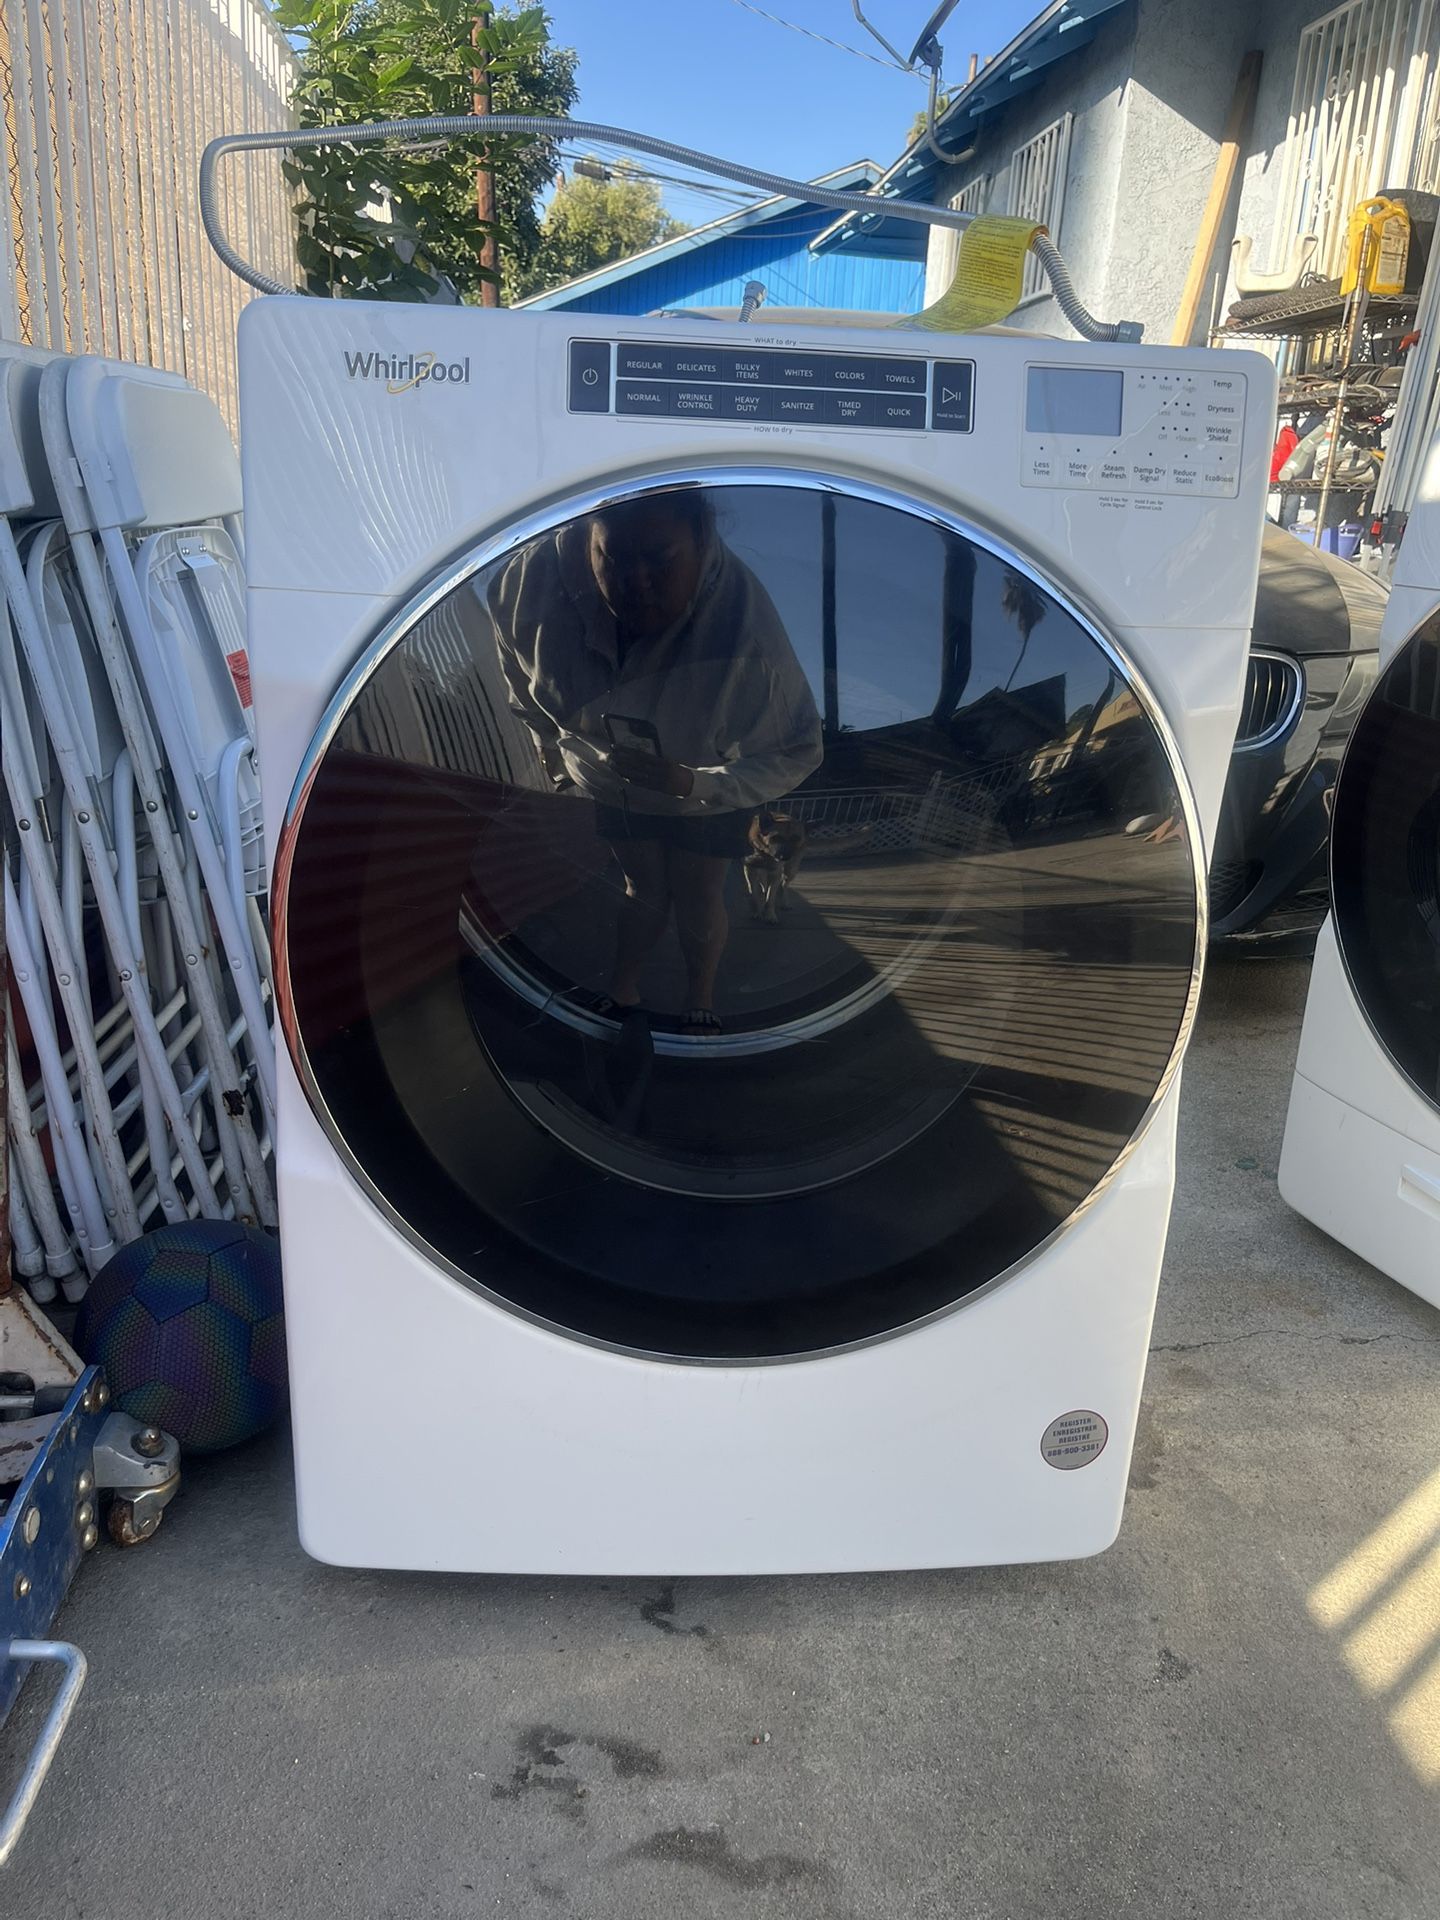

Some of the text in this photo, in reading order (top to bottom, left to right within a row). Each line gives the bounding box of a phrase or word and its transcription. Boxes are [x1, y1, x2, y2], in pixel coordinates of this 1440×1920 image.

[344, 351, 470, 388] Whirlpool
[627, 361, 663, 370] REGULAR
[676, 363, 717, 373] DELICATES
[735, 363, 760, 372] BULKY
[736, 371, 759, 379] ITEMS
[784, 368, 814, 378] WHITES
[834, 371, 865, 381] COLORS
[885, 374, 915, 384] TOWELS
[1213, 380, 1232, 389] Temp
[627, 393, 661, 402] NORMAL
[679, 393, 713, 402] WRINKLE
[735, 396, 760, 404] HEAVY
[677, 401, 714, 410] CONTROL
[736, 403, 758, 412] DUTY
[781, 401, 815, 411] SANITIZE
[838, 401, 861, 409] TIMED
[1207, 404, 1235, 414] Dryness
[841, 408, 857, 417] DRY
[887, 407, 911, 417] QUICK
[1206, 426, 1232, 435] Wrinkle
[1208, 434, 1229, 442] Shield
[1034, 461, 1050, 469] Less
[1069, 462, 1087, 470] More
[1103, 464, 1125, 472] Steam
[1033, 468, 1050, 476] Time
[1069, 470, 1087, 478] Time
[1133, 466, 1167, 476] Damp Dry
[1173, 468, 1197, 477] Reduce
[1101, 472, 1127, 480] Refresh
[1139, 474, 1160, 483] Signal
[1175, 476, 1193, 484] Static
[1205, 474, 1234, 483] EcoBoost
[1060, 1418, 1092, 1428] REGISTER
